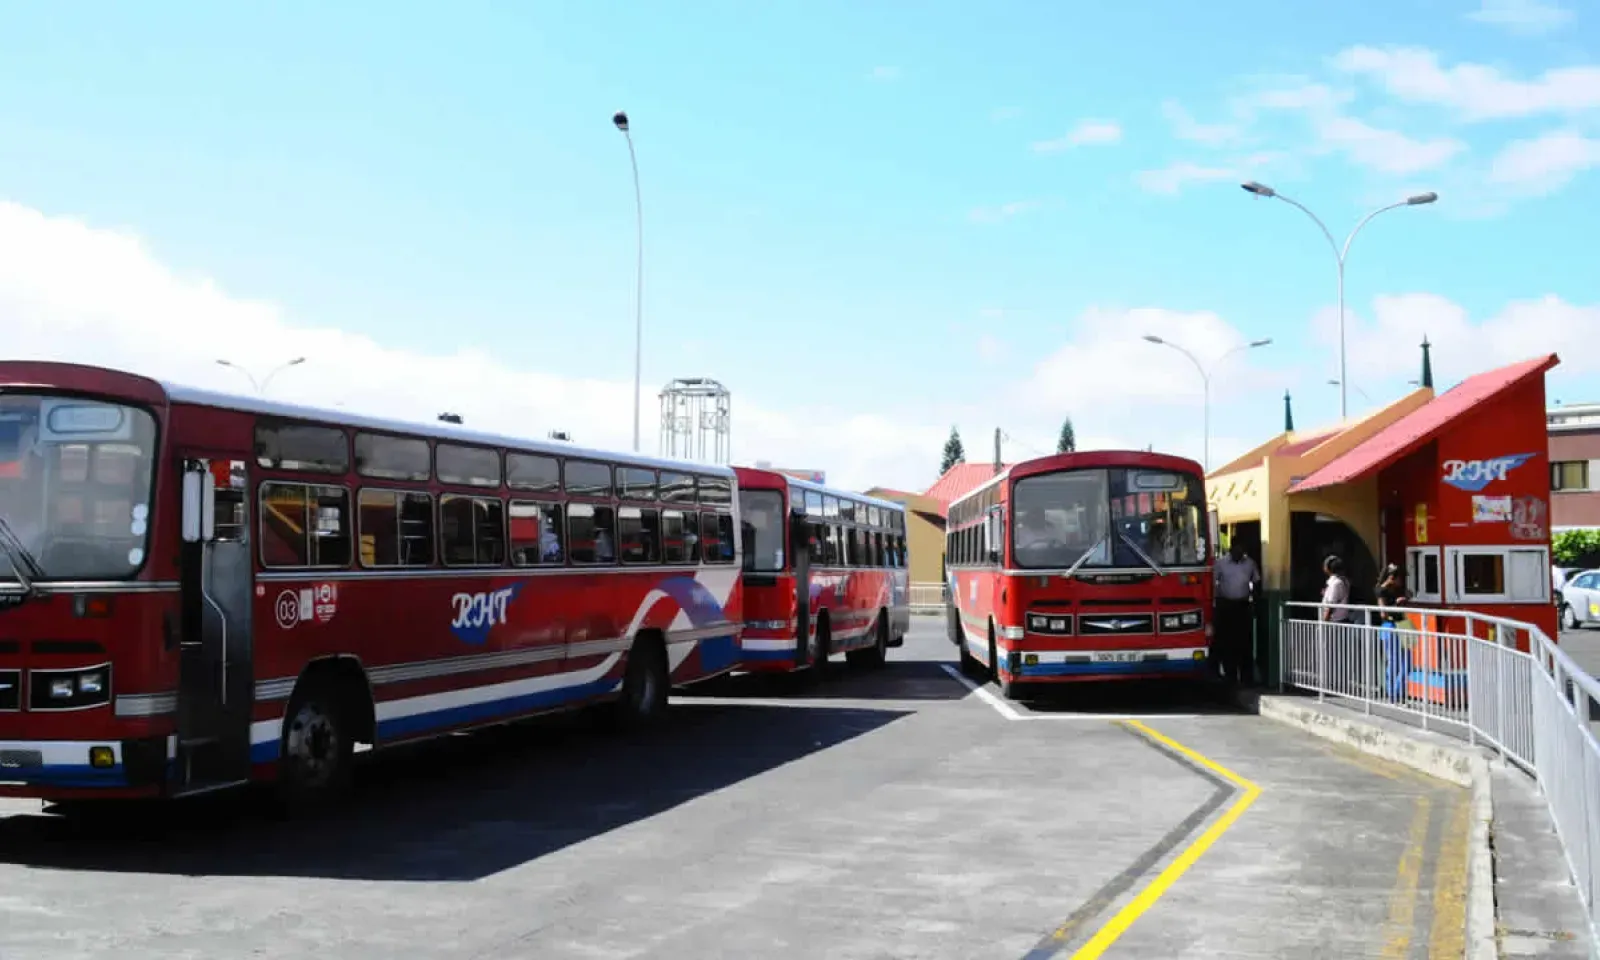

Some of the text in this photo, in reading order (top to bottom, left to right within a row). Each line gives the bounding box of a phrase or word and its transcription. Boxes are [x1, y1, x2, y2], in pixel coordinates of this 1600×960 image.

[1442, 459, 1514, 480] RHT
[280, 600, 296, 620] 03
[452, 588, 512, 628] RHT
